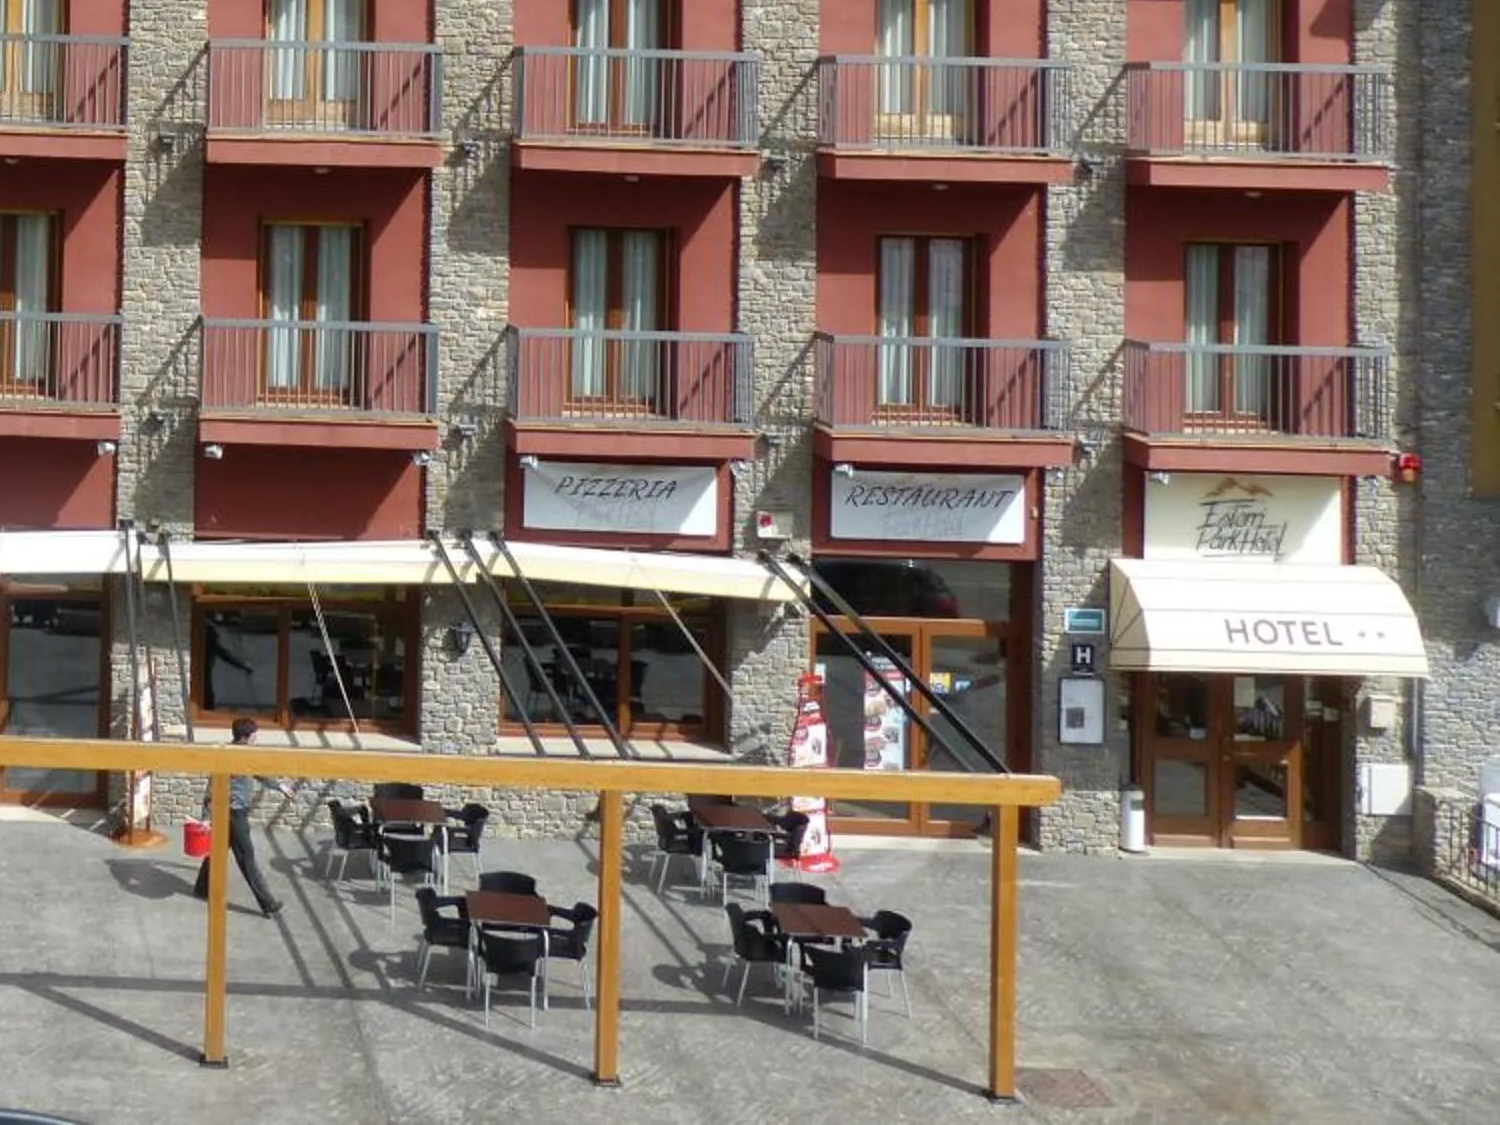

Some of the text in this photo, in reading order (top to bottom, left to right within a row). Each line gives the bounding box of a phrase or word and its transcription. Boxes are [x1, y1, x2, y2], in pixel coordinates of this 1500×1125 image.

[554, 475, 678, 501] PIZZERIA
[845, 484, 1013, 510] RESTAURANT
[1223, 618, 1344, 646] HOTEL
[1076, 646, 1091, 664] H
